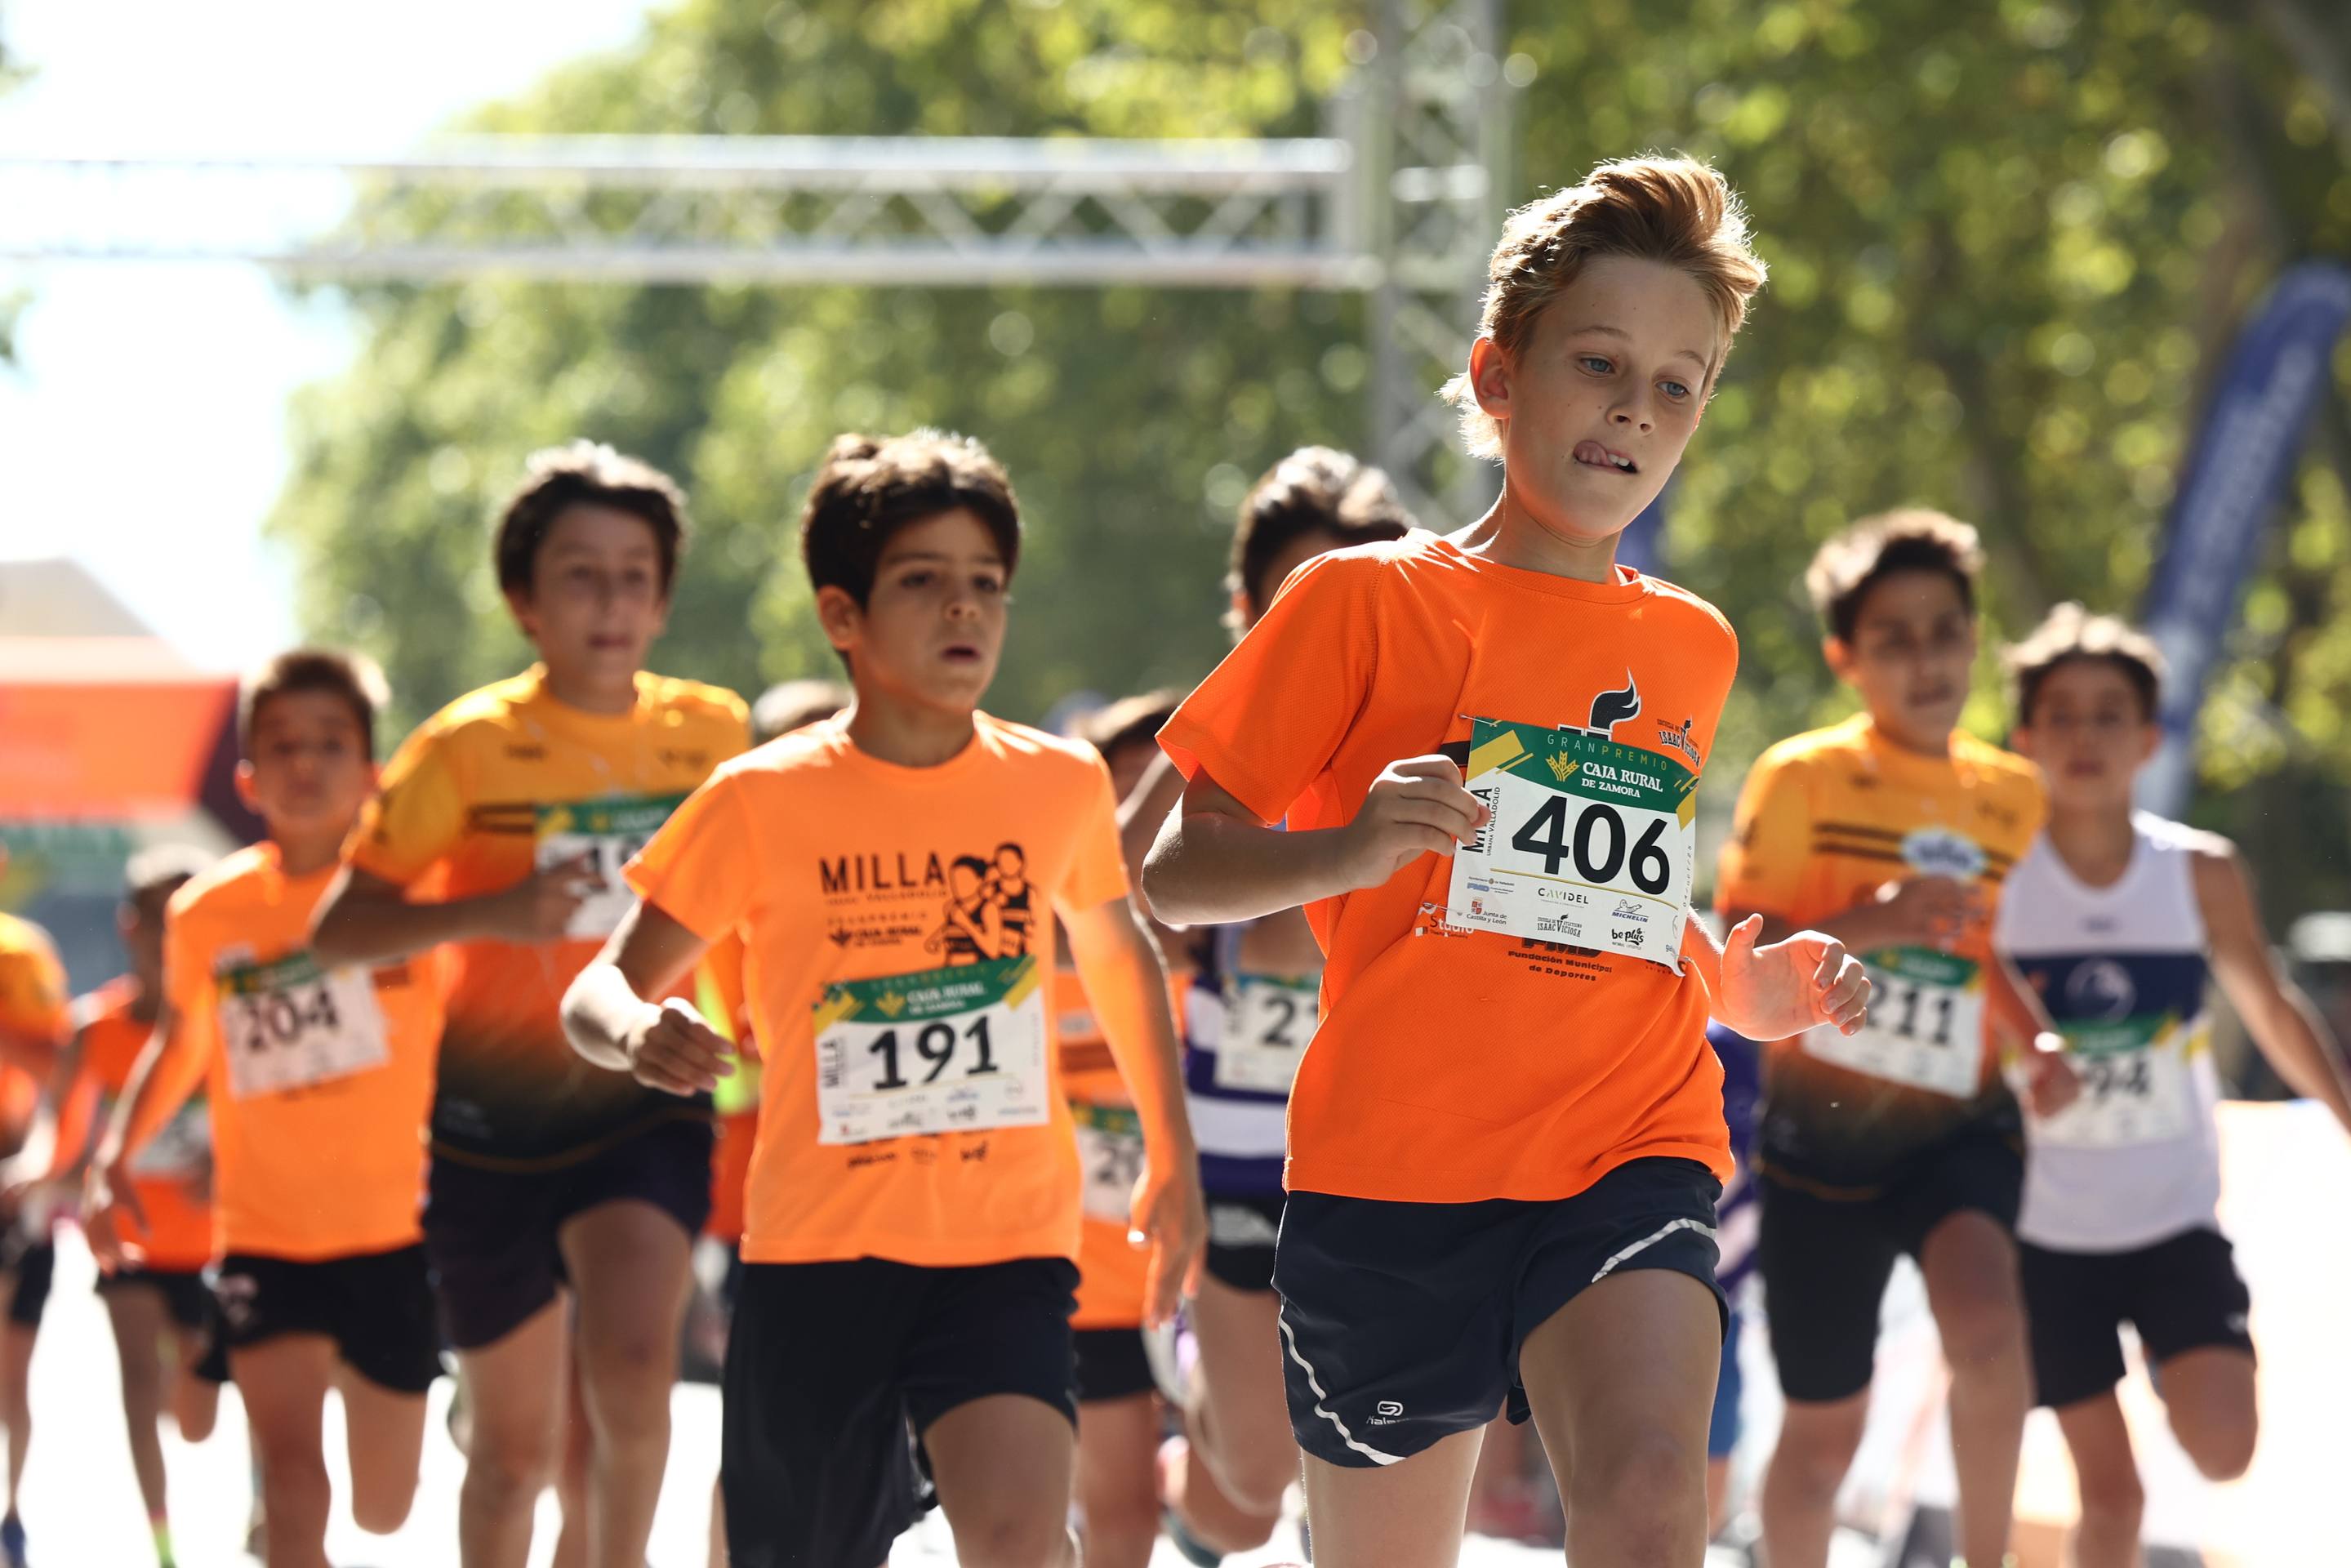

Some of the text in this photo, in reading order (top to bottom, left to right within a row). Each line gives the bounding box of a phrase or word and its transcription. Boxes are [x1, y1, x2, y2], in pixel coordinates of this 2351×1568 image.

[1582, 777, 1641, 798] DE ZAMORA
[1583, 762, 1663, 792] CAJA RURAL
[1486, 786, 1500, 856] URBANA VALLADOLID
[1512, 795, 1670, 895] 406
[819, 852, 946, 894] MILLA
[1538, 888, 1589, 904] CAVIDEL
[1467, 913, 1487, 922] Castilla
[1611, 911, 1648, 923] MICHELIN
[1537, 920, 1581, 938] ISAAC VICIOSA
[1611, 929, 1644, 943] be plus
[1507, 951, 1612, 973] Fundación Municipal
[1545, 967, 1596, 981] Deportes
[869, 1015, 999, 1089] 191
